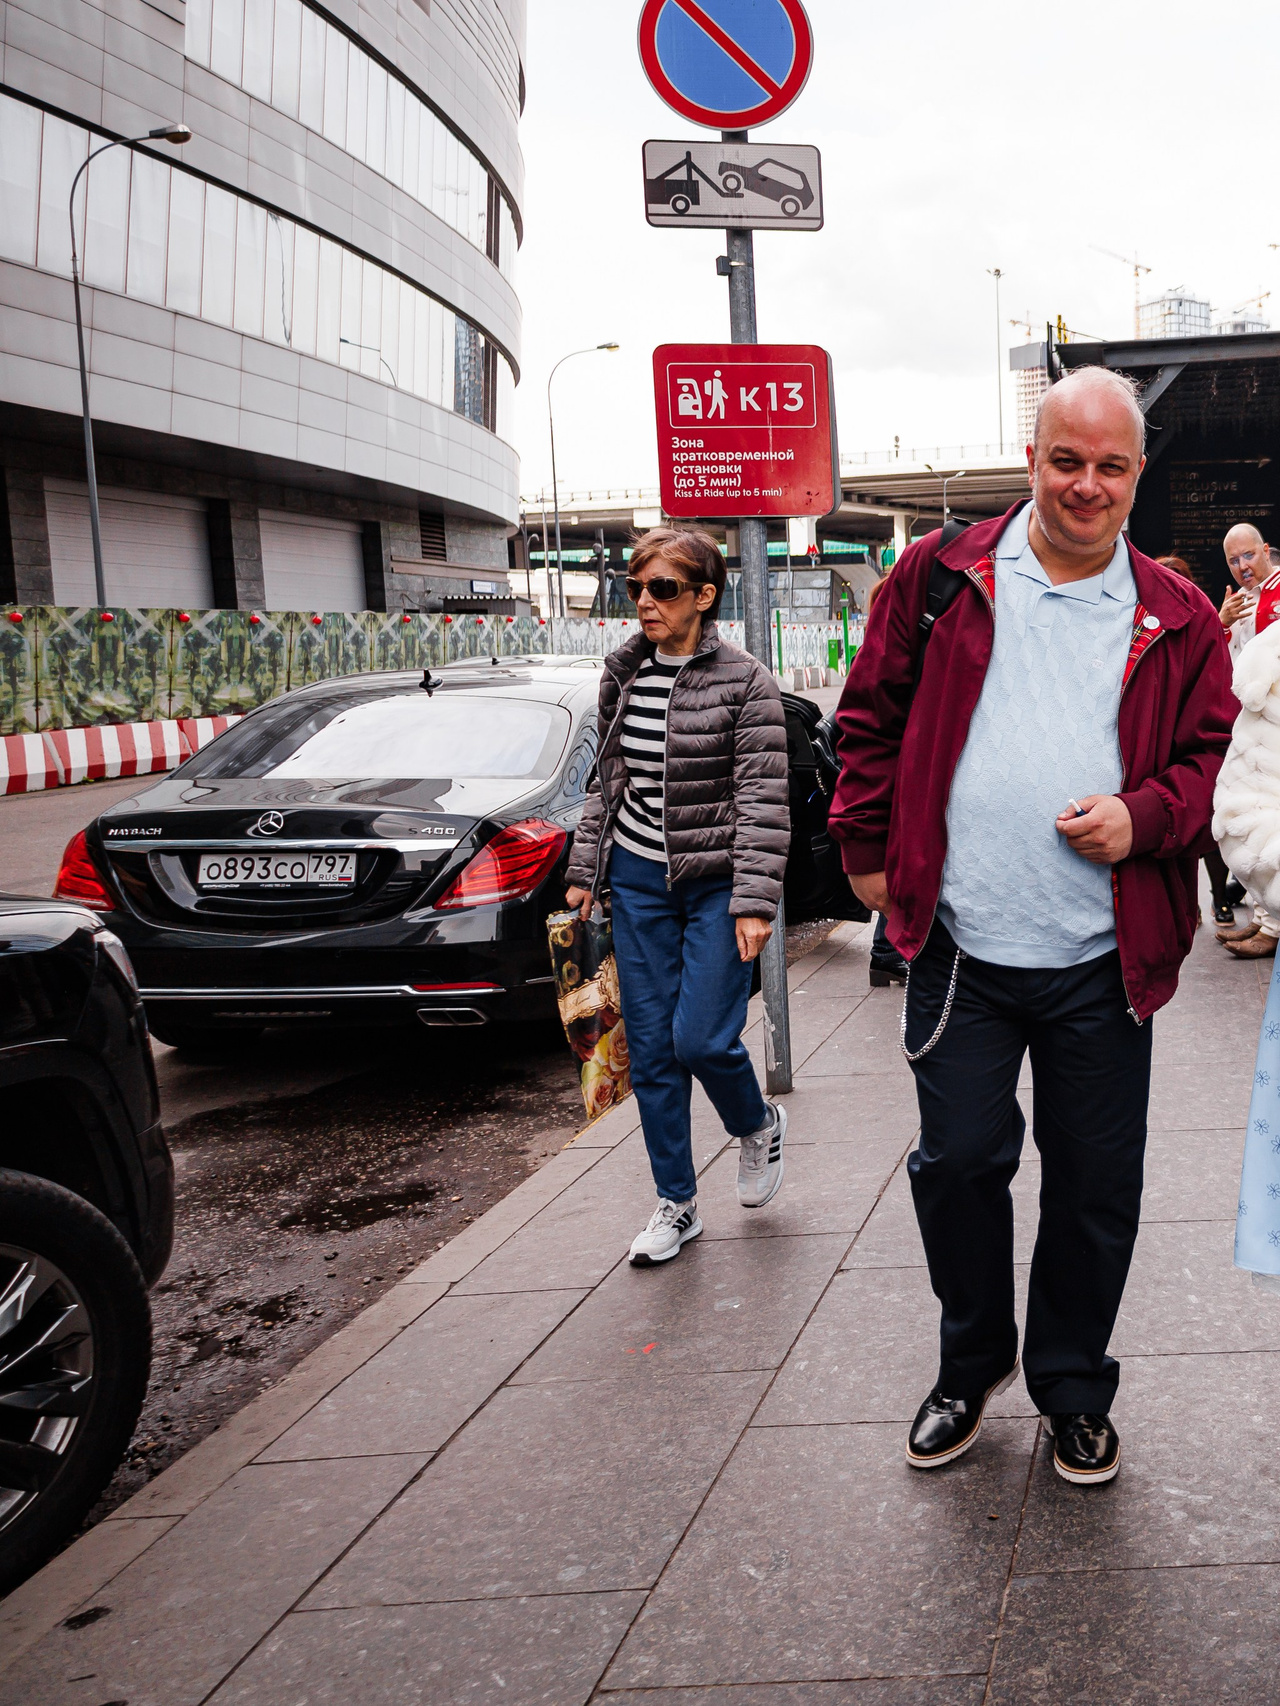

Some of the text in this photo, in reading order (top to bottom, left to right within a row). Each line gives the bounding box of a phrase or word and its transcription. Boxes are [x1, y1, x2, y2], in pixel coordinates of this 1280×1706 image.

[671, 436, 705, 449] Зона
[672, 449, 795, 464] кратковременной
[673, 464, 742, 475] остановки
[673, 474, 742, 489] (до 5 мин)
[1169, 480, 1238, 492] EXCLUSIVE
[674, 487, 783, 498] Kiss & Ride (up to 5 min)
[1169, 491, 1216, 503] HEIGHT
[108, 828, 162, 836] MAYBACH
[408, 827, 456, 835] S 400
[311, 855, 351, 874] 797
